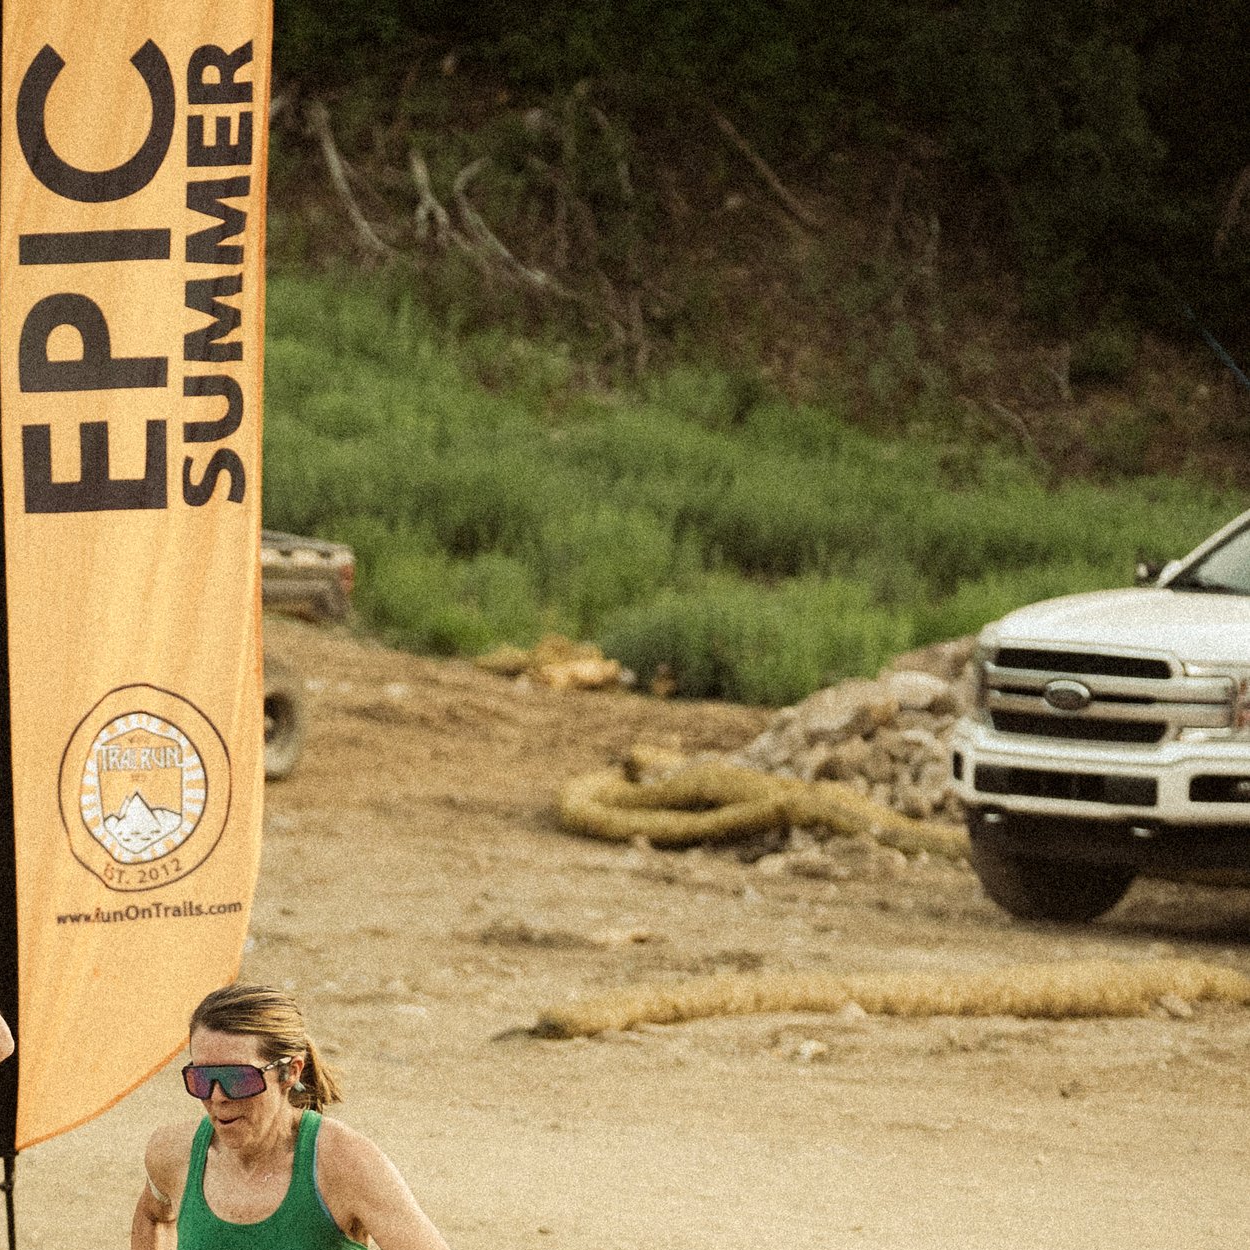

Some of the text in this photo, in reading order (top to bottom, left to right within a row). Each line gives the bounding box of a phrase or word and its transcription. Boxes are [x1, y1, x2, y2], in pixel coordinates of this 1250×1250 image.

[16, 38, 176, 514] EPIC
[182, 39, 254, 507] SUMMER
[138, 857, 183, 884] 2012
